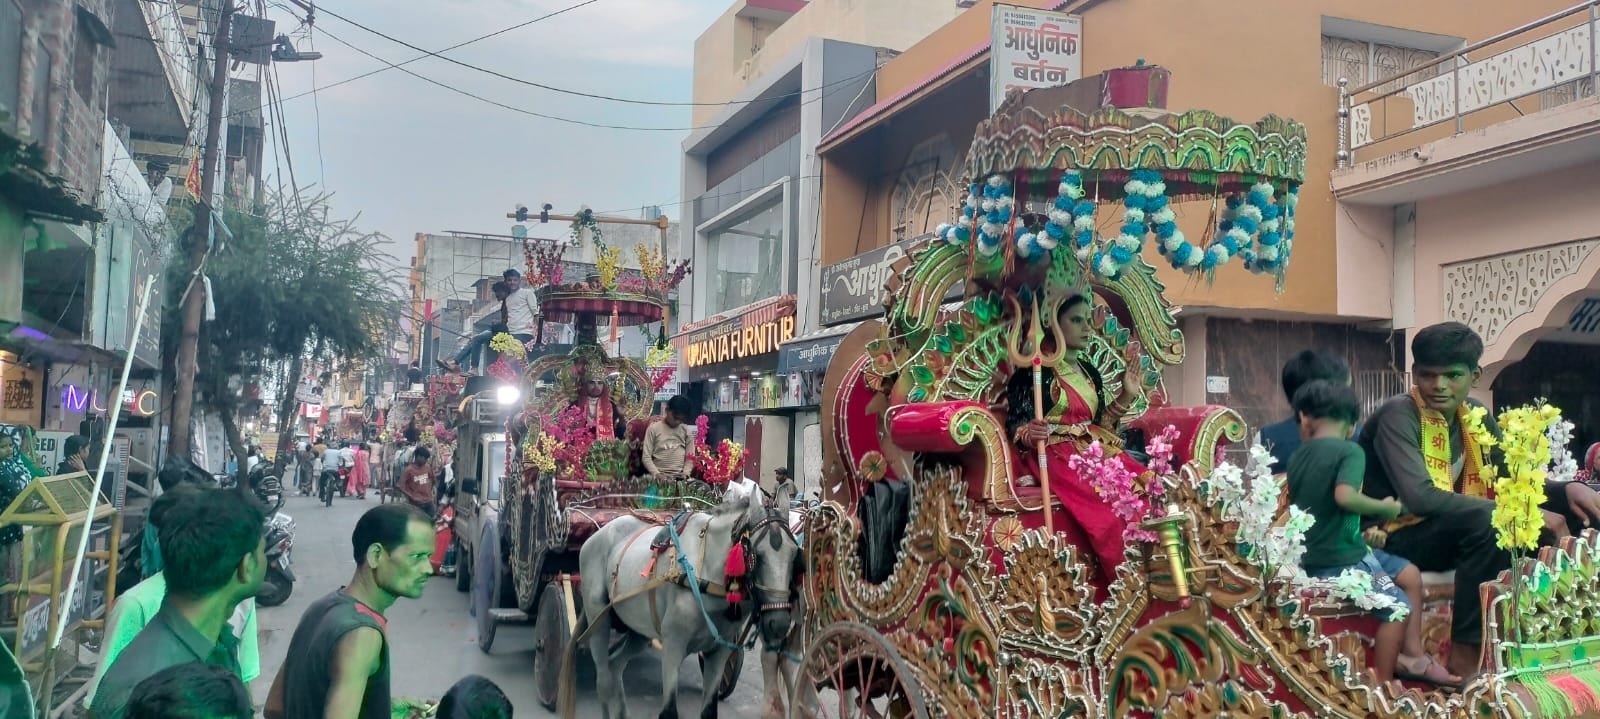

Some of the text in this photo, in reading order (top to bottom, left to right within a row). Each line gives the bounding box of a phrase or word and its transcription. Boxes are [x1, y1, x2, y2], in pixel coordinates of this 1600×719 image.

[1005, 23, 1078, 60] आधुनिक
[1011, 60, 1069, 82] बर्तन
[798, 344, 828, 362] आधुनिक
[1431, 432, 1446, 451] श्री
[1426, 455, 1447, 474] राम
